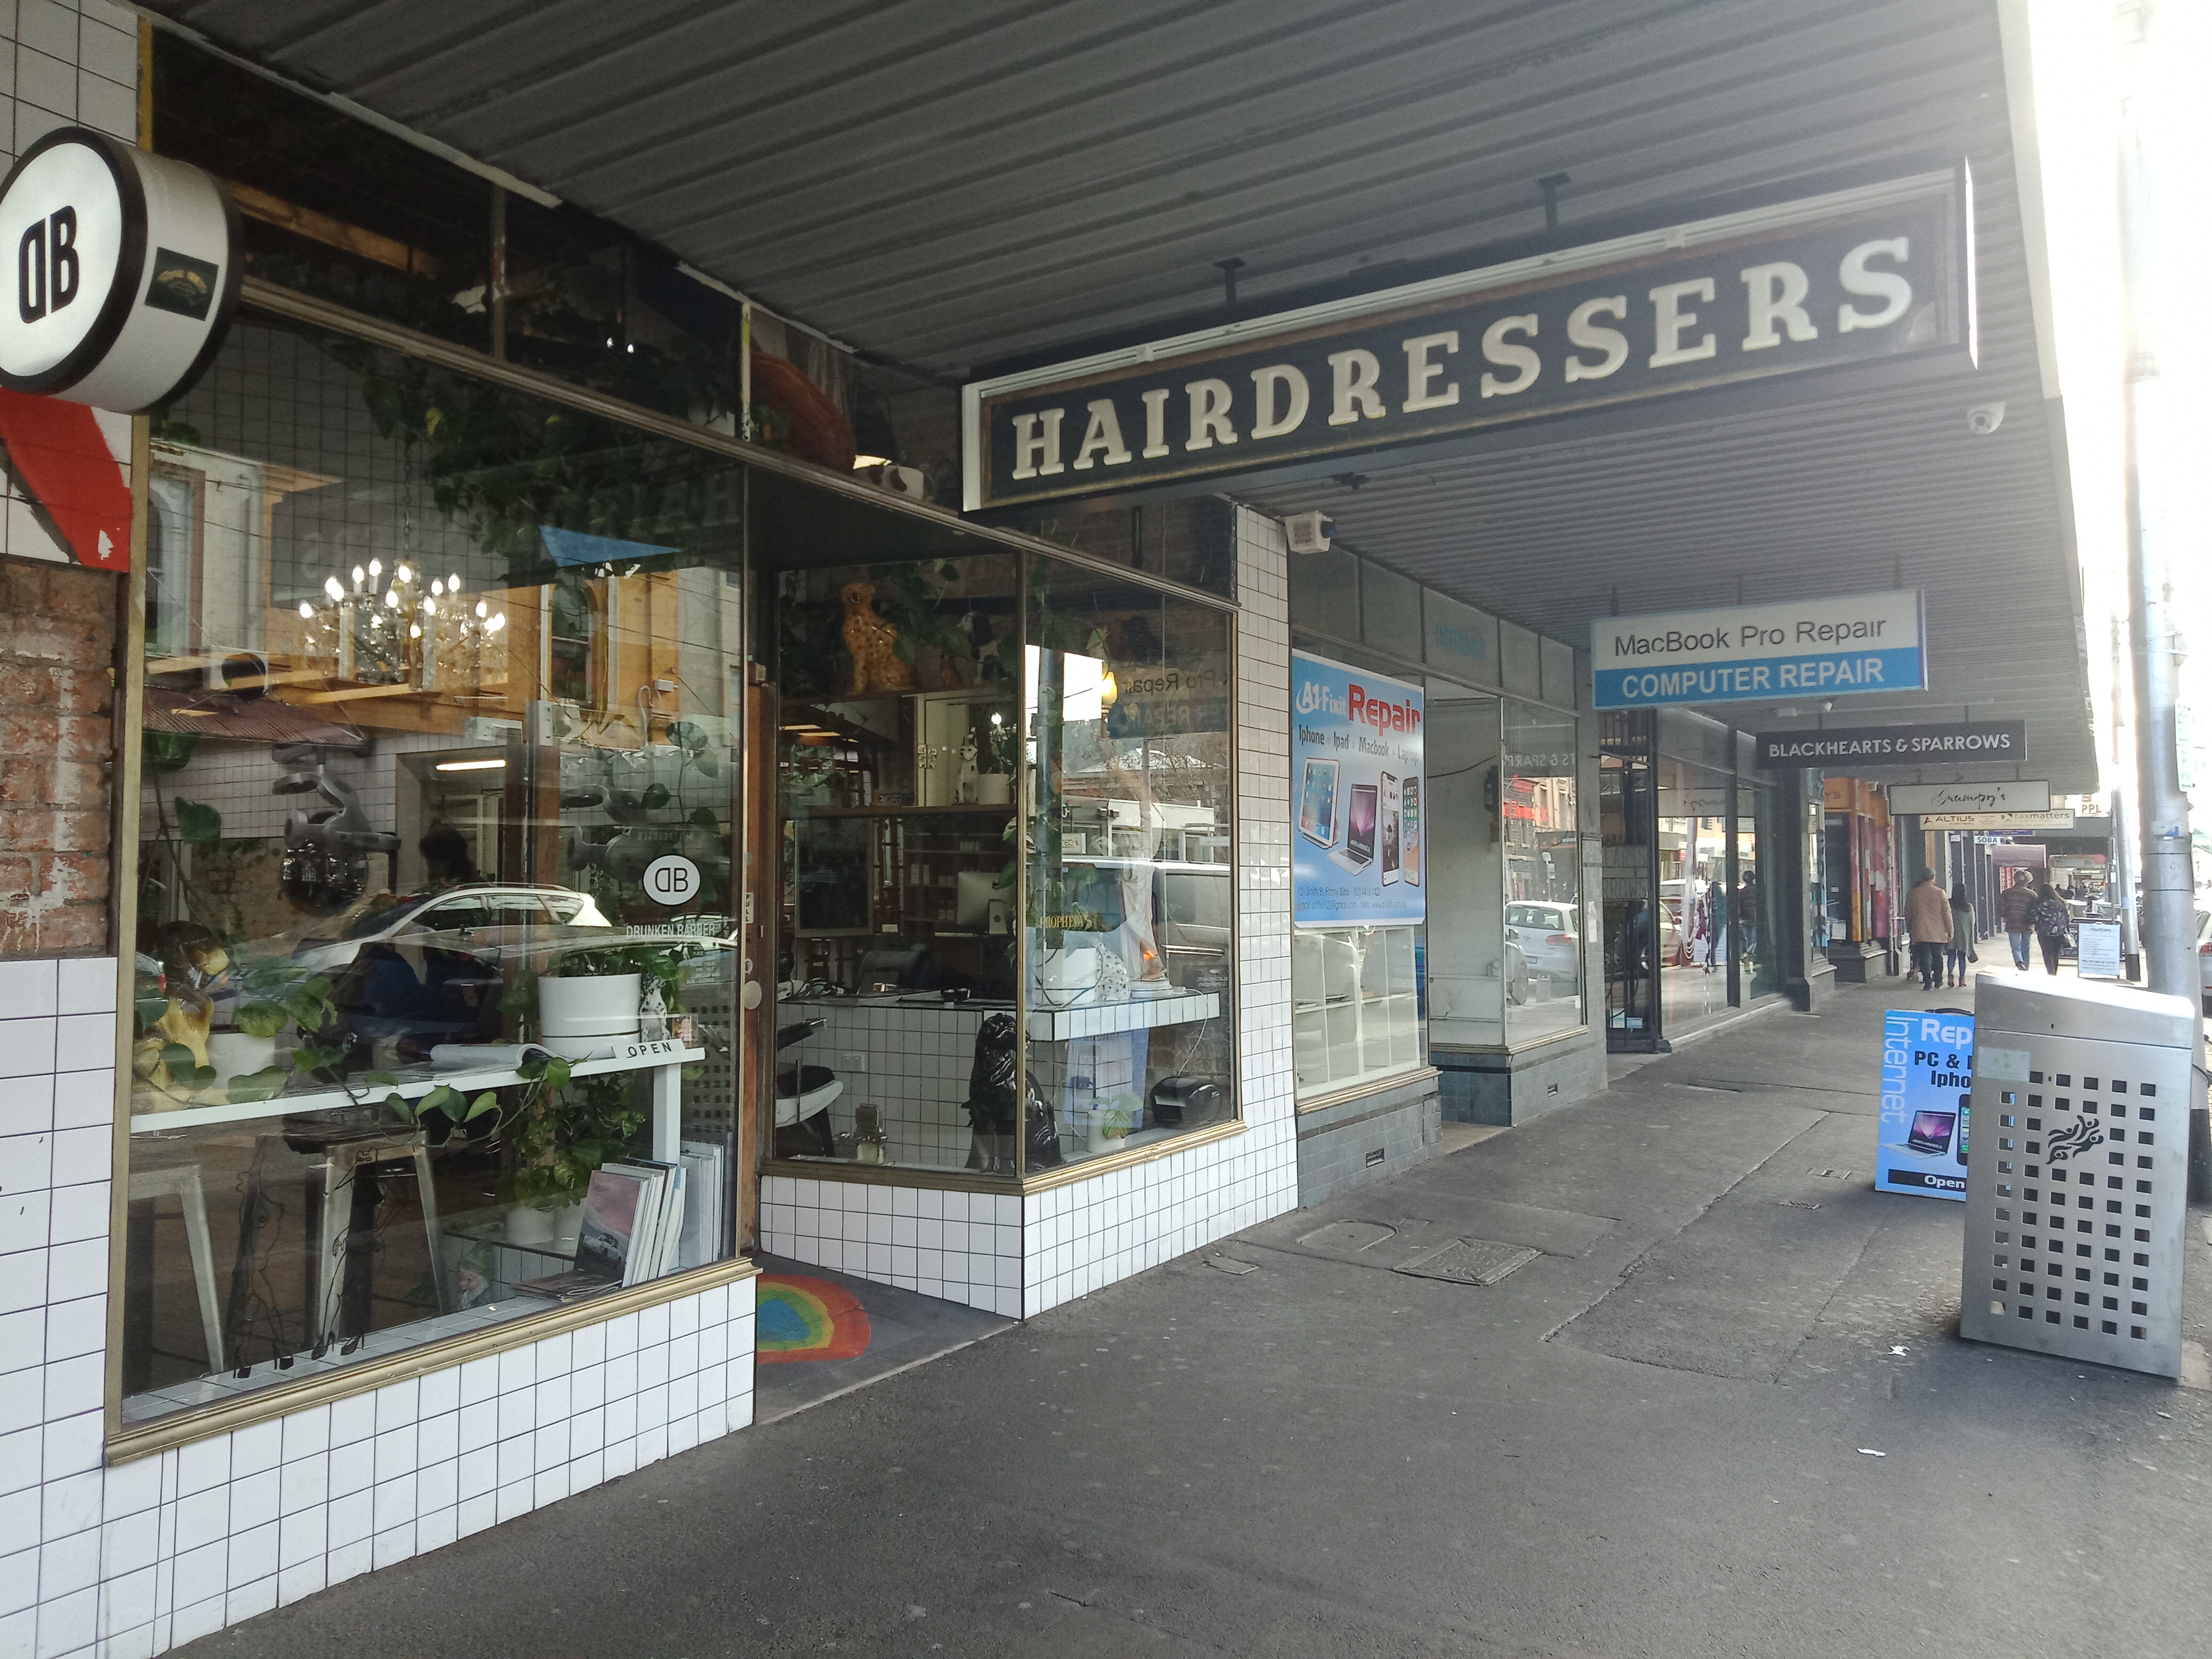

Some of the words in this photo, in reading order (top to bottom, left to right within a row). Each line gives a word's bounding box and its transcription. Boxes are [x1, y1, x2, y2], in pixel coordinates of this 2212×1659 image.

[1010, 235, 1913, 481] HAIRDRESSERS
[1614, 627, 1729, 657] MacBook
[1740, 625, 1785, 647] Pro
[1795, 618, 1887, 646] Repair
[1622, 665, 1771, 699] COMPUTER
[1780, 657, 1884, 688] REPAIR
[1348, 683, 1421, 736] Repair
[1299, 724, 1325, 745] Iphone
[1334, 731, 1349, 752] Ipad
[1359, 736, 1389, 758] Macbook
[1397, 745, 1419, 764] Laptop
[1769, 739, 1892, 758] BLACKHEARTS
[1895, 738, 1907, 753] &
[1911, 733, 2012, 752] SPARROWS
[2014, 811, 2070, 819] taxmatters
[626, 923, 674, 939] DRUNKEN
[677, 923, 716, 936] BARBER
[1921, 1018, 1972, 1050] Rep
[627, 1042, 672, 1058] OPEN
[1914, 1050, 1939, 1067] PC
[1946, 1053, 1960, 1069] &
[1881, 1016, 1919, 1124] Internet
[1931, 1070, 1971, 1088] Ipho
[1924, 1175, 1965, 1189] Open
